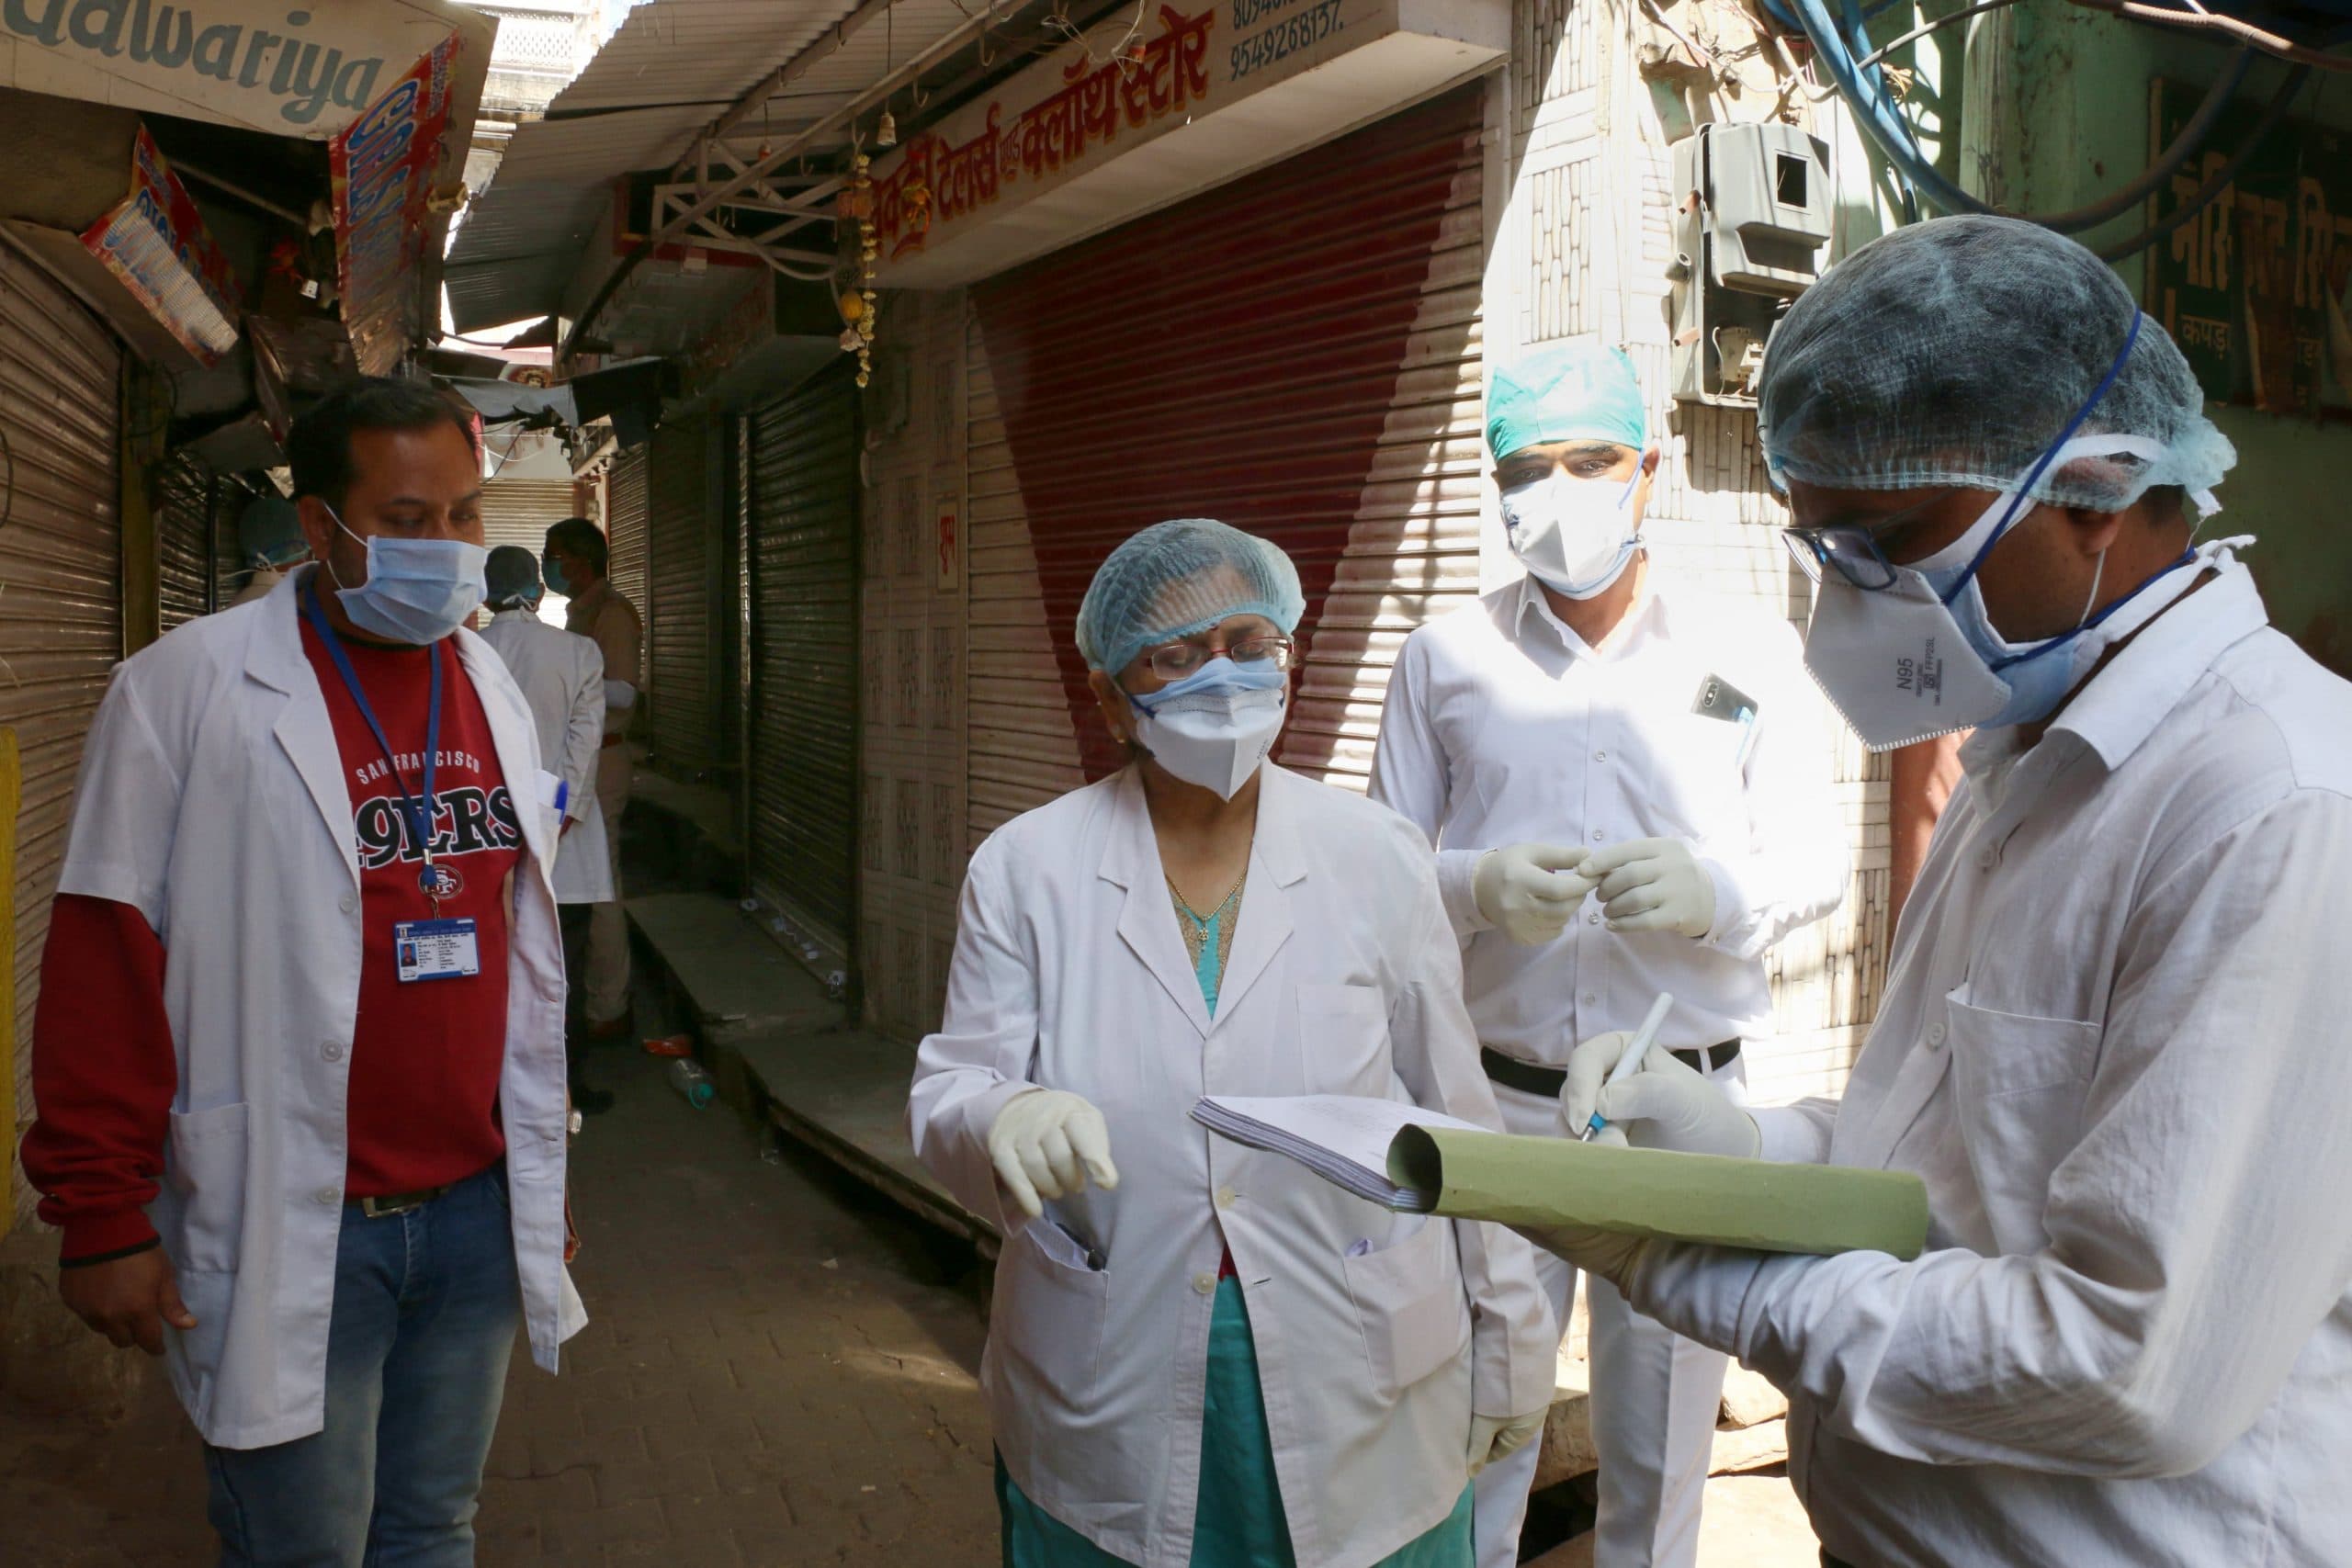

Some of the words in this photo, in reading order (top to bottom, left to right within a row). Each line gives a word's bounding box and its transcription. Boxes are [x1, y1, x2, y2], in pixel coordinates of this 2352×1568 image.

[1121, 4, 1215, 127] स्टोर
[1896, 658, 1913, 690] N95
[356, 759, 390, 784] SAN
[355, 786, 522, 870] 9ERS
